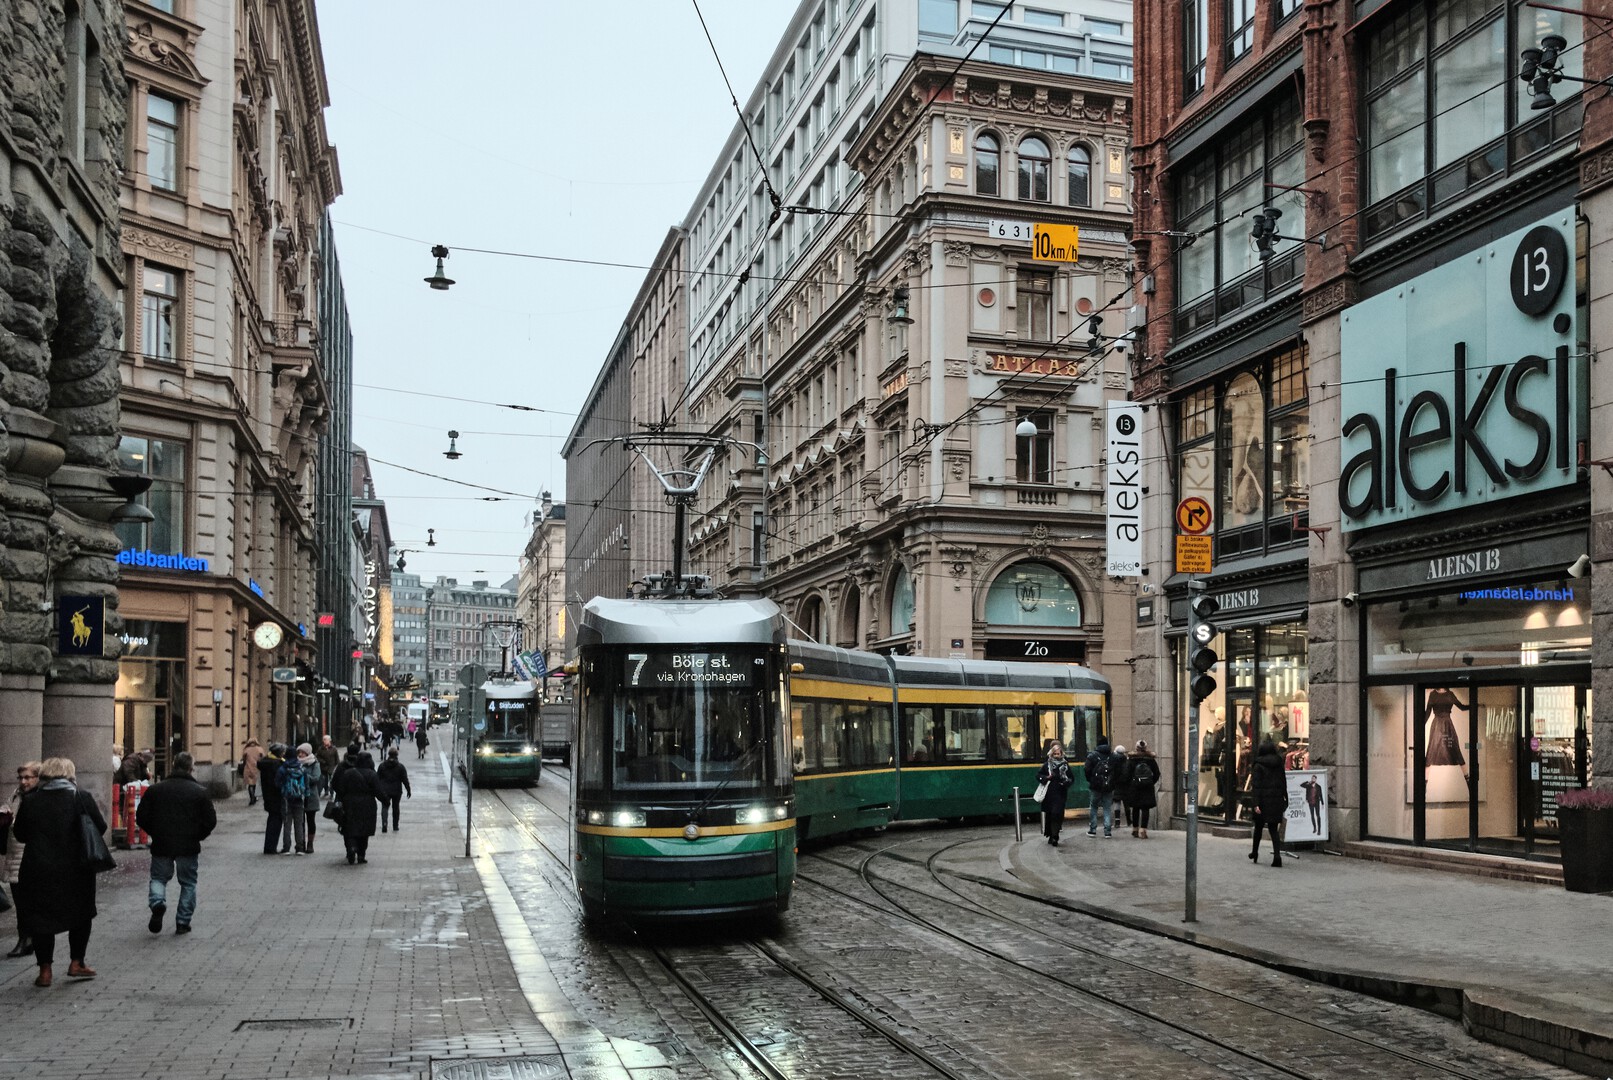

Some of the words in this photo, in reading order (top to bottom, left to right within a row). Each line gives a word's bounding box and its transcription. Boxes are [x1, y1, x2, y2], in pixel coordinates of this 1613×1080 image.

[1523, 246, 1551, 297] 13
[993, 354, 1078, 376] ATLAS
[1338, 313, 1571, 520] aleksi
[1120, 419, 1131, 431] 13
[1109, 440, 1139, 542] aleksi
[1109, 562, 1135, 572] aleksi
[1426, 551, 1481, 580] ALEKSI
[1485, 548, 1500, 571] 13
[1249, 588, 1259, 606] 13
[1024, 641, 1048, 656] Zio
[628, 653, 648, 685] 7
[710, 655, 731, 668] st.
[657, 671, 675, 682] via
[678, 671, 746, 684] Kronohagen
[488, 700, 496, 712] 4
[1287, 809, 1306, 818] -20%
